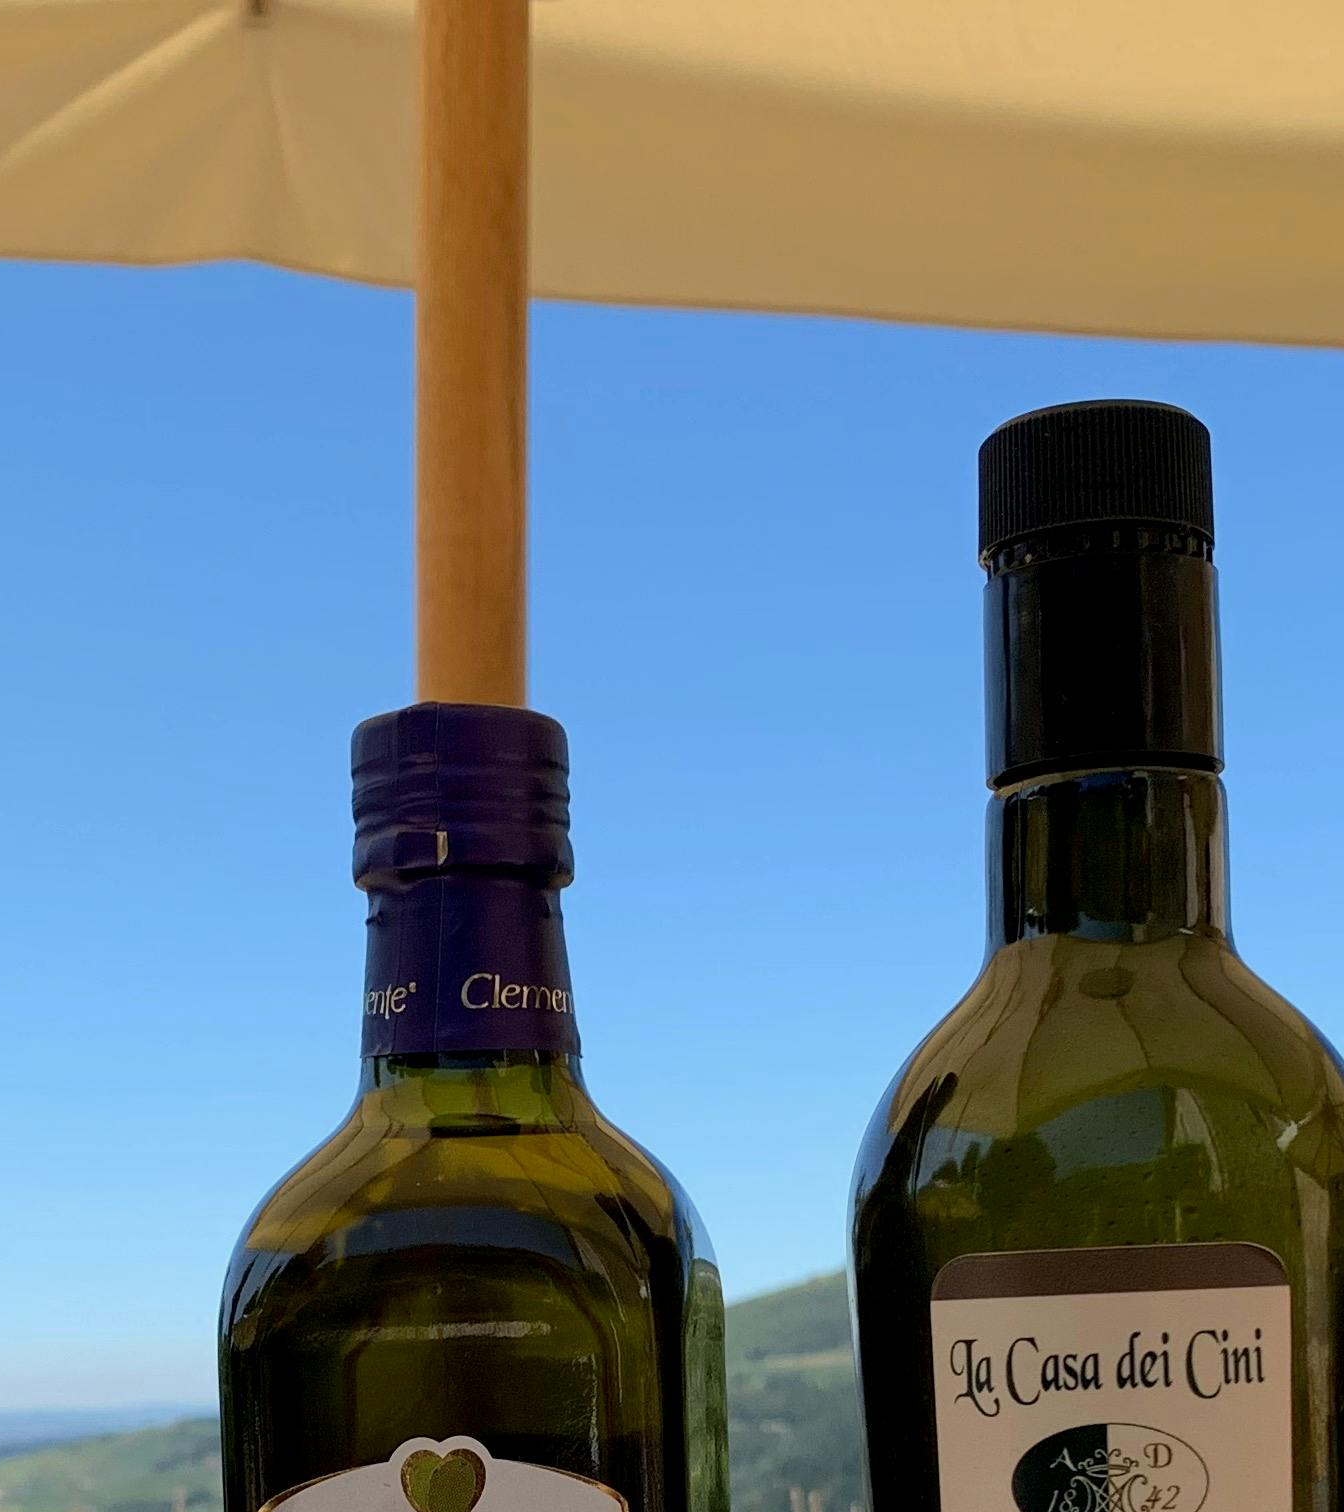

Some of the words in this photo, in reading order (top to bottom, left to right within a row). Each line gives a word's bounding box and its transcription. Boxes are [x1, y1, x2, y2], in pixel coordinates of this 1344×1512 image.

[950, 1338, 1000, 1417] La
[1006, 1337, 1103, 1405] Casa
[1116, 1331, 1172, 1389] dei
[1186, 1328, 1265, 1399] Cini
